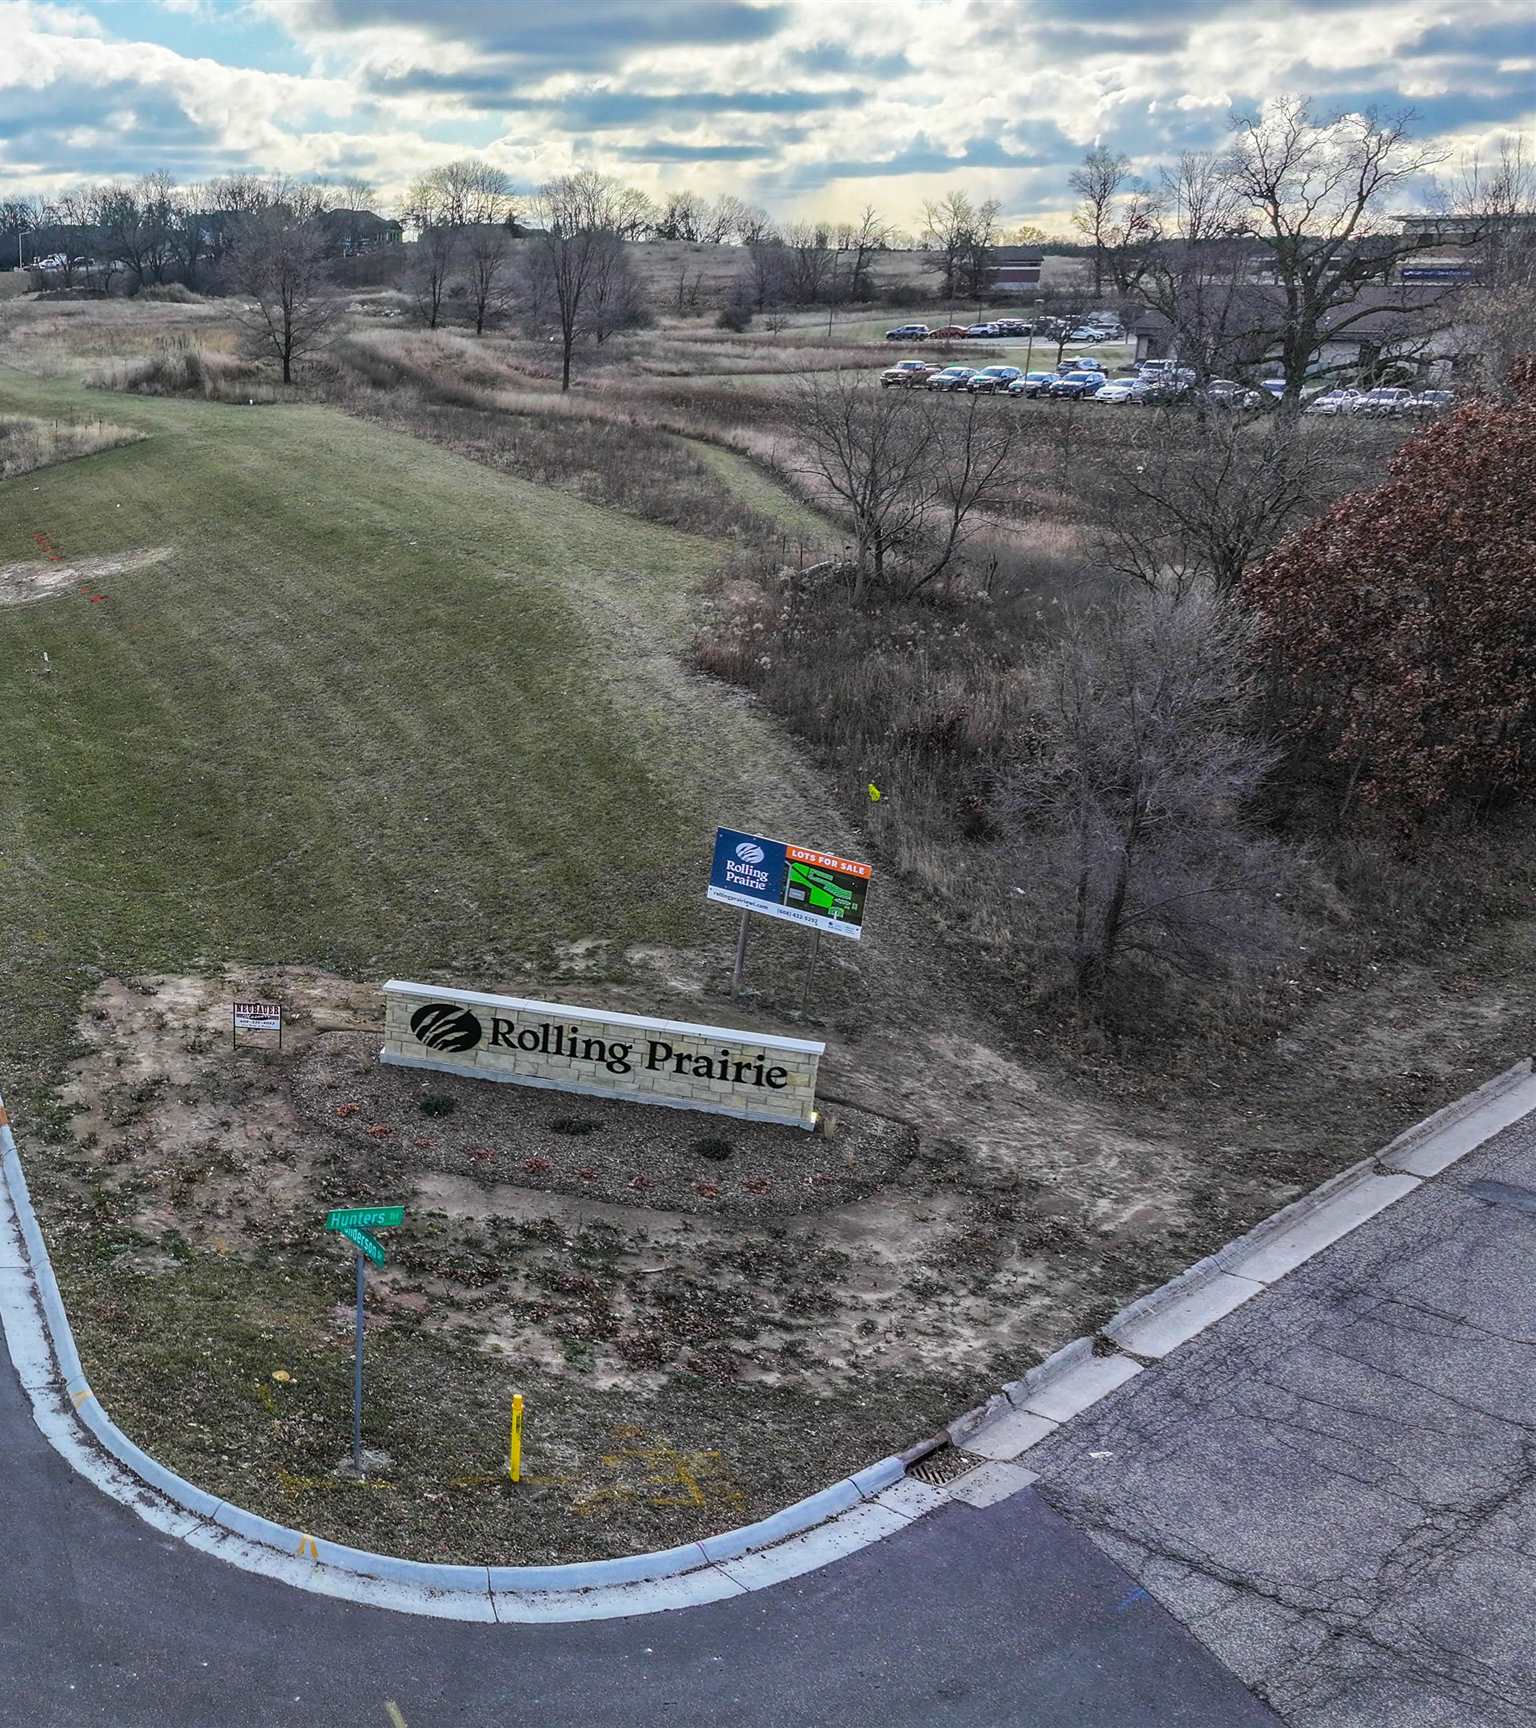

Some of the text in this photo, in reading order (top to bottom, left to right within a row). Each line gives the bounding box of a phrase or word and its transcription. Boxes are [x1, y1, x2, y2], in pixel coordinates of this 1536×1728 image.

[726, 859, 769, 882] Rolling
[792, 849, 865, 875] LOTS FOR SALE
[725, 870, 766, 890] Prairie
[236, 1003, 279, 1014] NEUBAUER
[489, 1017, 788, 1089] Rolling Prairie
[330, 1212, 385, 1227] Hunters
